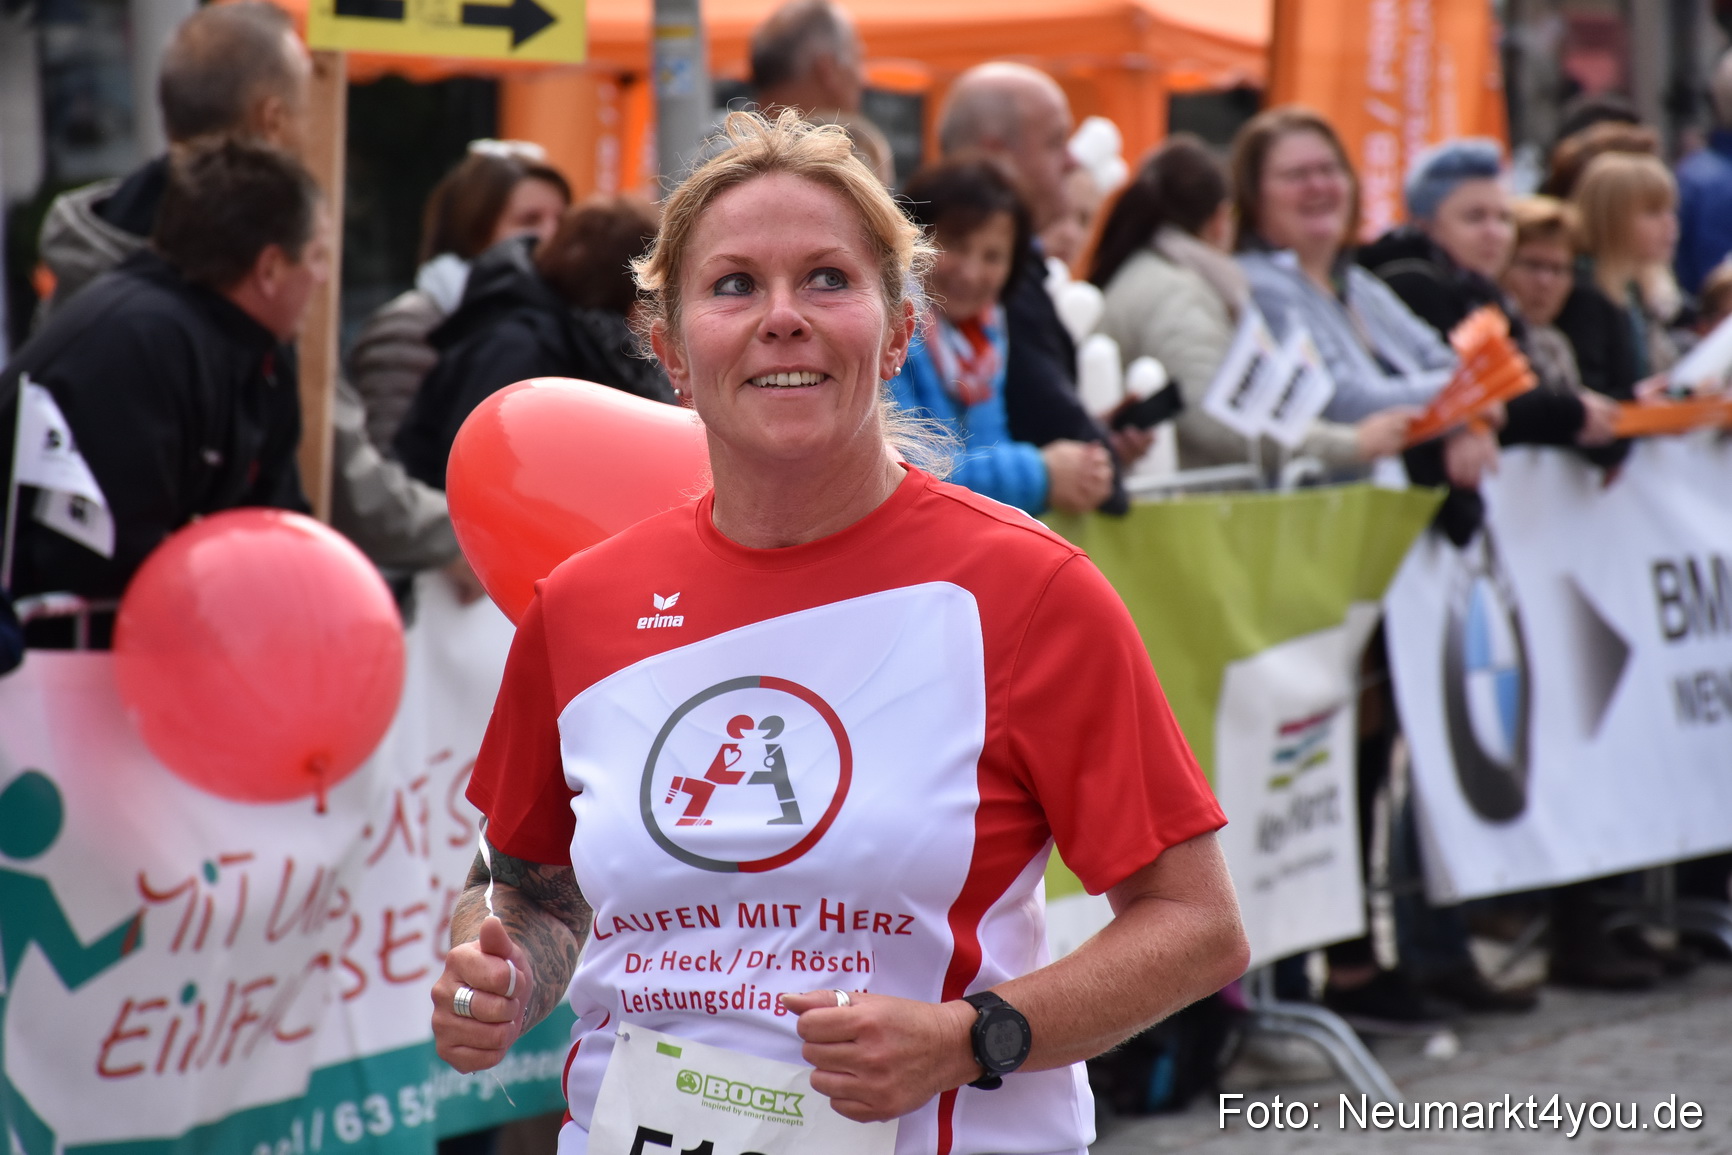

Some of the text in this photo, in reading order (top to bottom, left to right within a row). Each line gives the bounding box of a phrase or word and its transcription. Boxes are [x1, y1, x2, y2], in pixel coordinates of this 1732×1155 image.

[637, 613, 684, 630] erima
[593, 898, 915, 941] LAUFEN MIT HERZ
[625, 953, 653, 973] Dr.
[660, 951, 722, 973] Heck
[727, 949, 743, 974] /
[746, 950, 782, 971] Dr.
[701, 1099, 804, 1127] inspired by smart concepts
[703, 1075, 804, 1117] BOCK
[333, 1094, 393, 1144] 63
